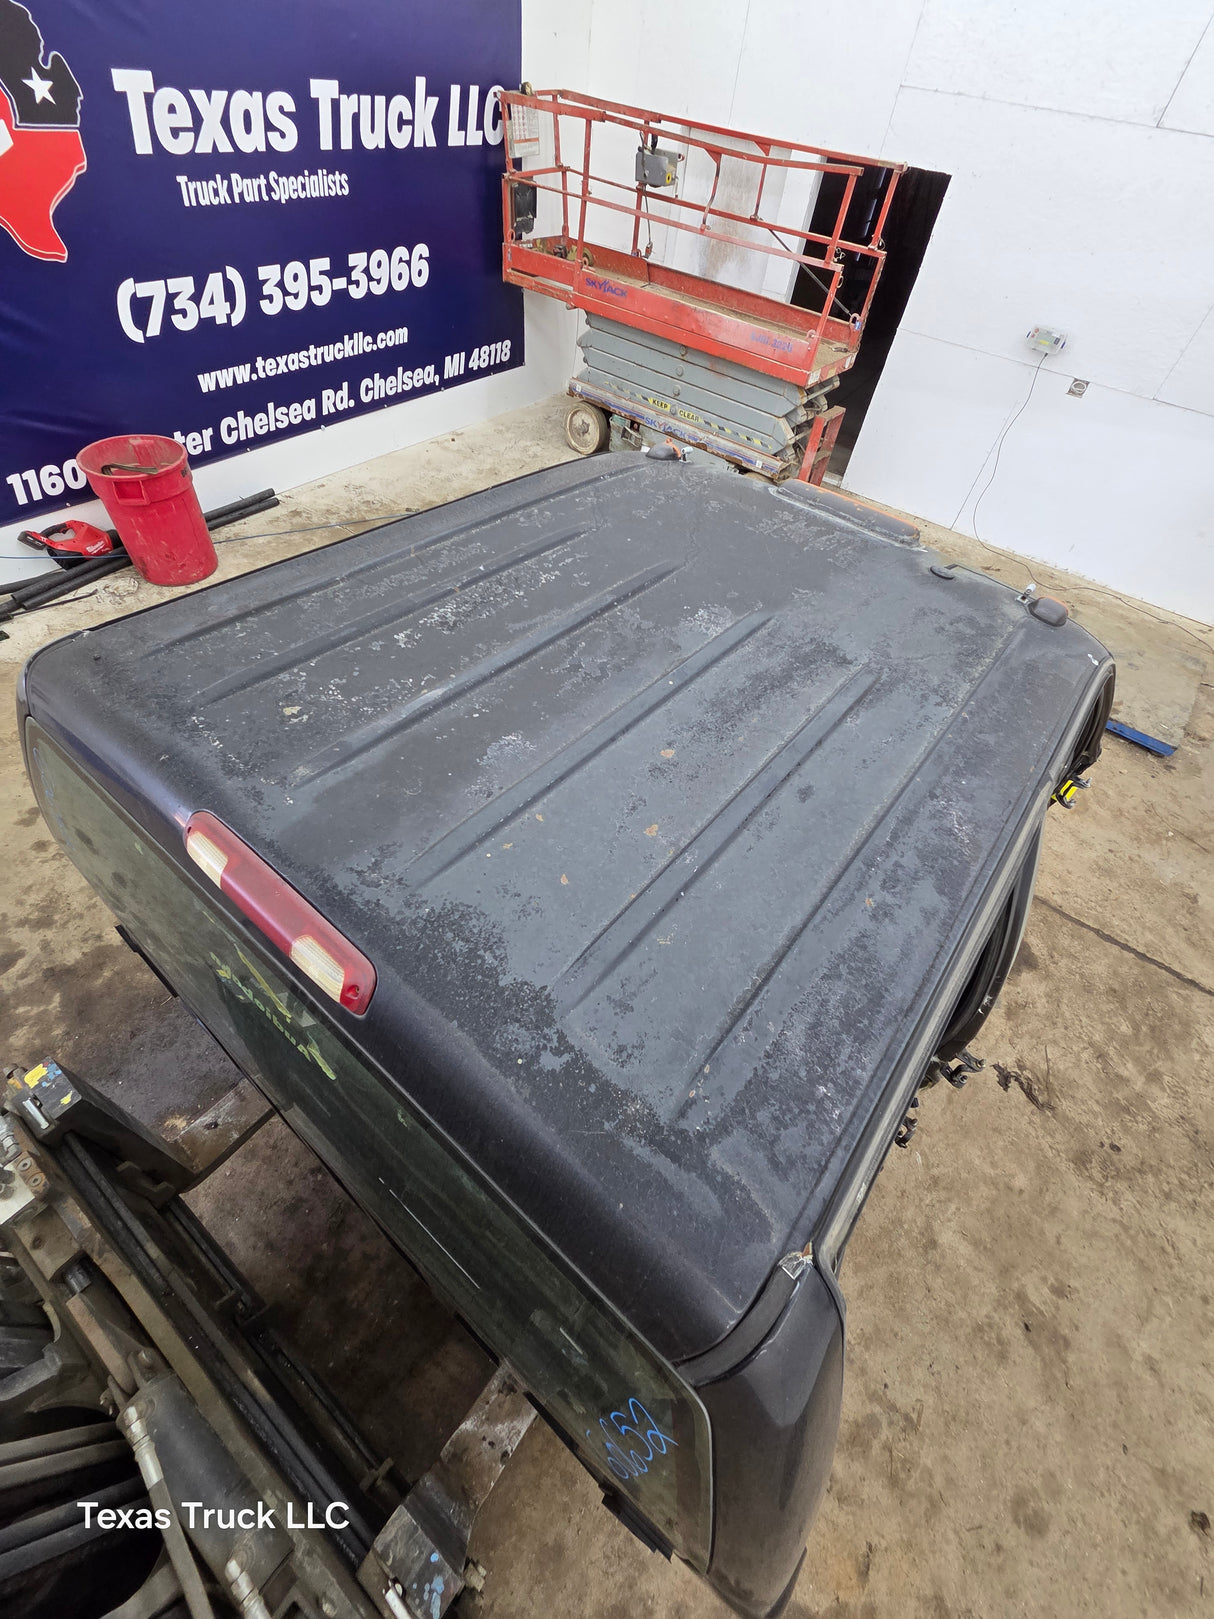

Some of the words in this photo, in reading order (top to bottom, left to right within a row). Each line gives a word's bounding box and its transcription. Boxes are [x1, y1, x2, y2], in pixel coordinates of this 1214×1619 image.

[111, 68, 298, 155] Texas
[310, 76, 439, 150] Truck
[448, 84, 505, 146] LLC
[177, 175, 229, 207] Truck
[231, 173, 268, 203] Part
[269, 169, 349, 204] Specialists
[117, 266, 246, 343] (734)
[258, 243, 429, 315] 395-3966
[197, 326, 408, 393] www.texastruckllc.com
[220, 401, 317, 447] Chelsea
[322, 382, 354, 415] Rd.
[360, 366, 440, 404] Chelsea,
[444, 352, 465, 379] MI
[469, 340, 511, 371] 48118
[652, 399, 668, 409] KEEP
[679, 409, 699, 422] CLEAR
